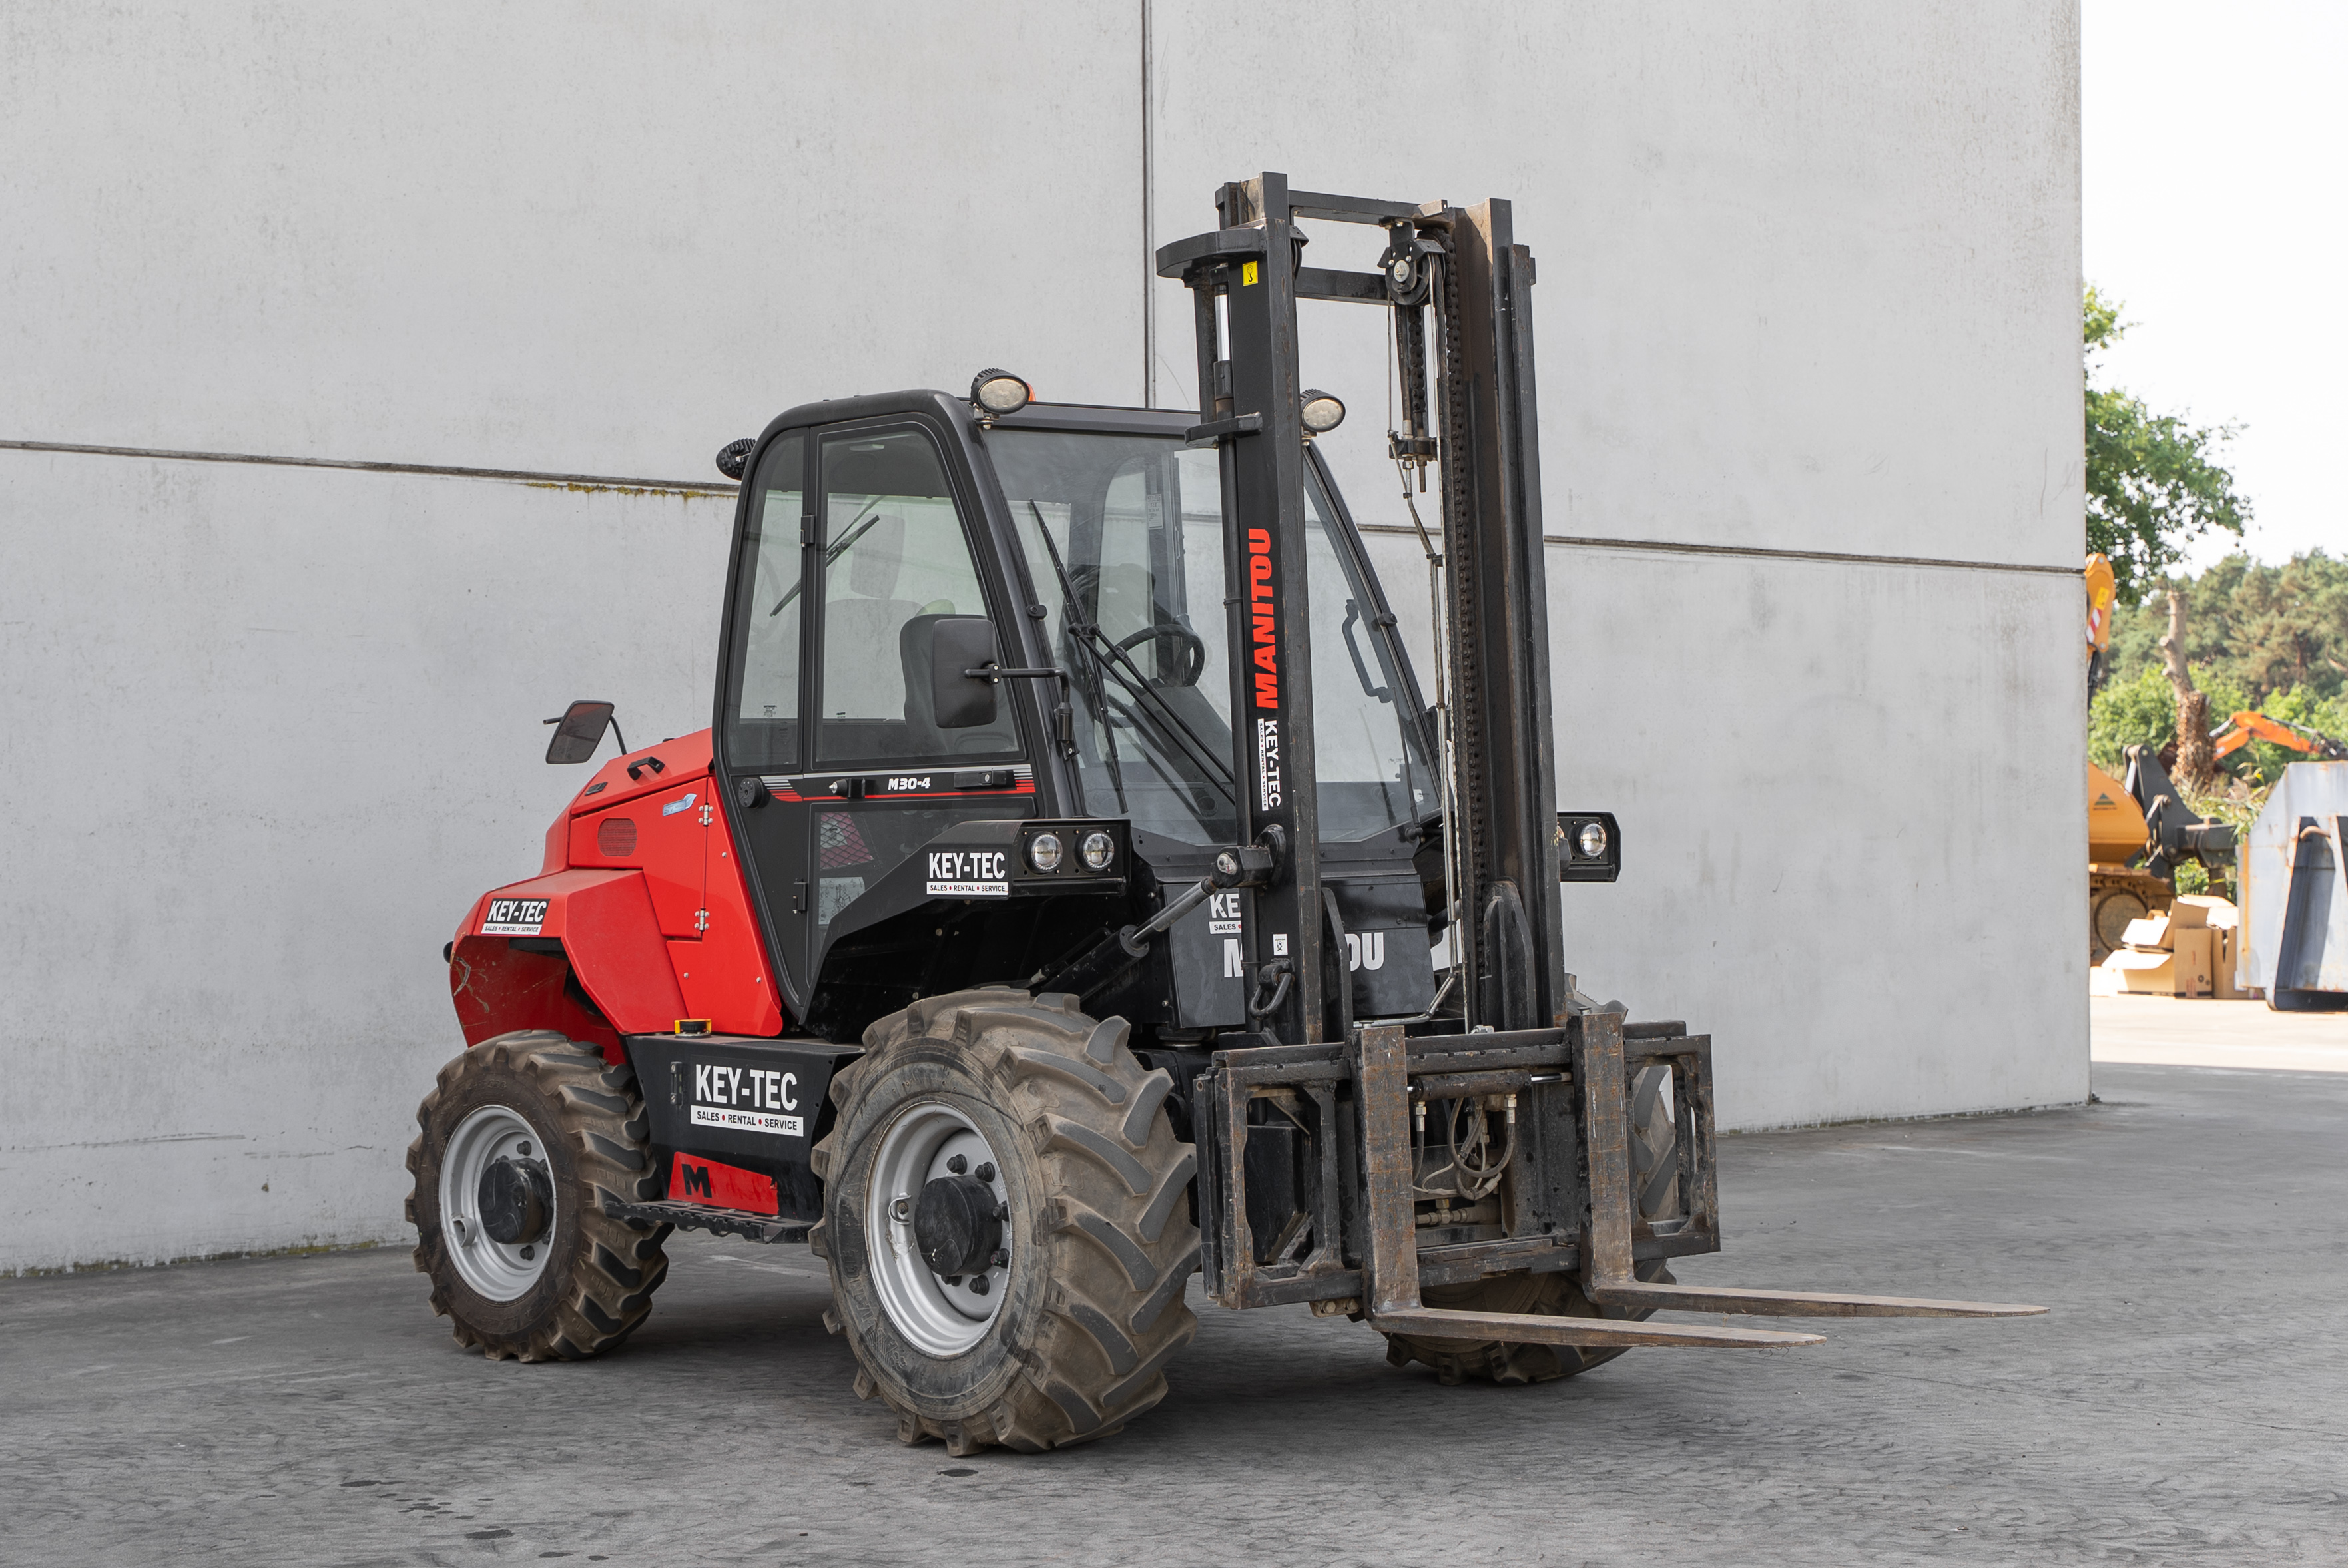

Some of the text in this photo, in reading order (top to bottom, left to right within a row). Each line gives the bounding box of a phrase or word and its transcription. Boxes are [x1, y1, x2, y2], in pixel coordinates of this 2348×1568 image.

[1248, 528, 1278, 709] MANITOU
[1265, 720, 1281, 808] KEY-TEC
[888, 776, 931, 790] M30-4
[929, 852, 1006, 879] KEY-TEC
[487, 900, 547, 923] KEY-TEC
[1209, 893, 1241, 919] KE
[696, 1064, 798, 1111] KEY-TEC
[697, 1110, 798, 1131] SALES RENTAL SERVICE
[681, 1163, 713, 1198] M
